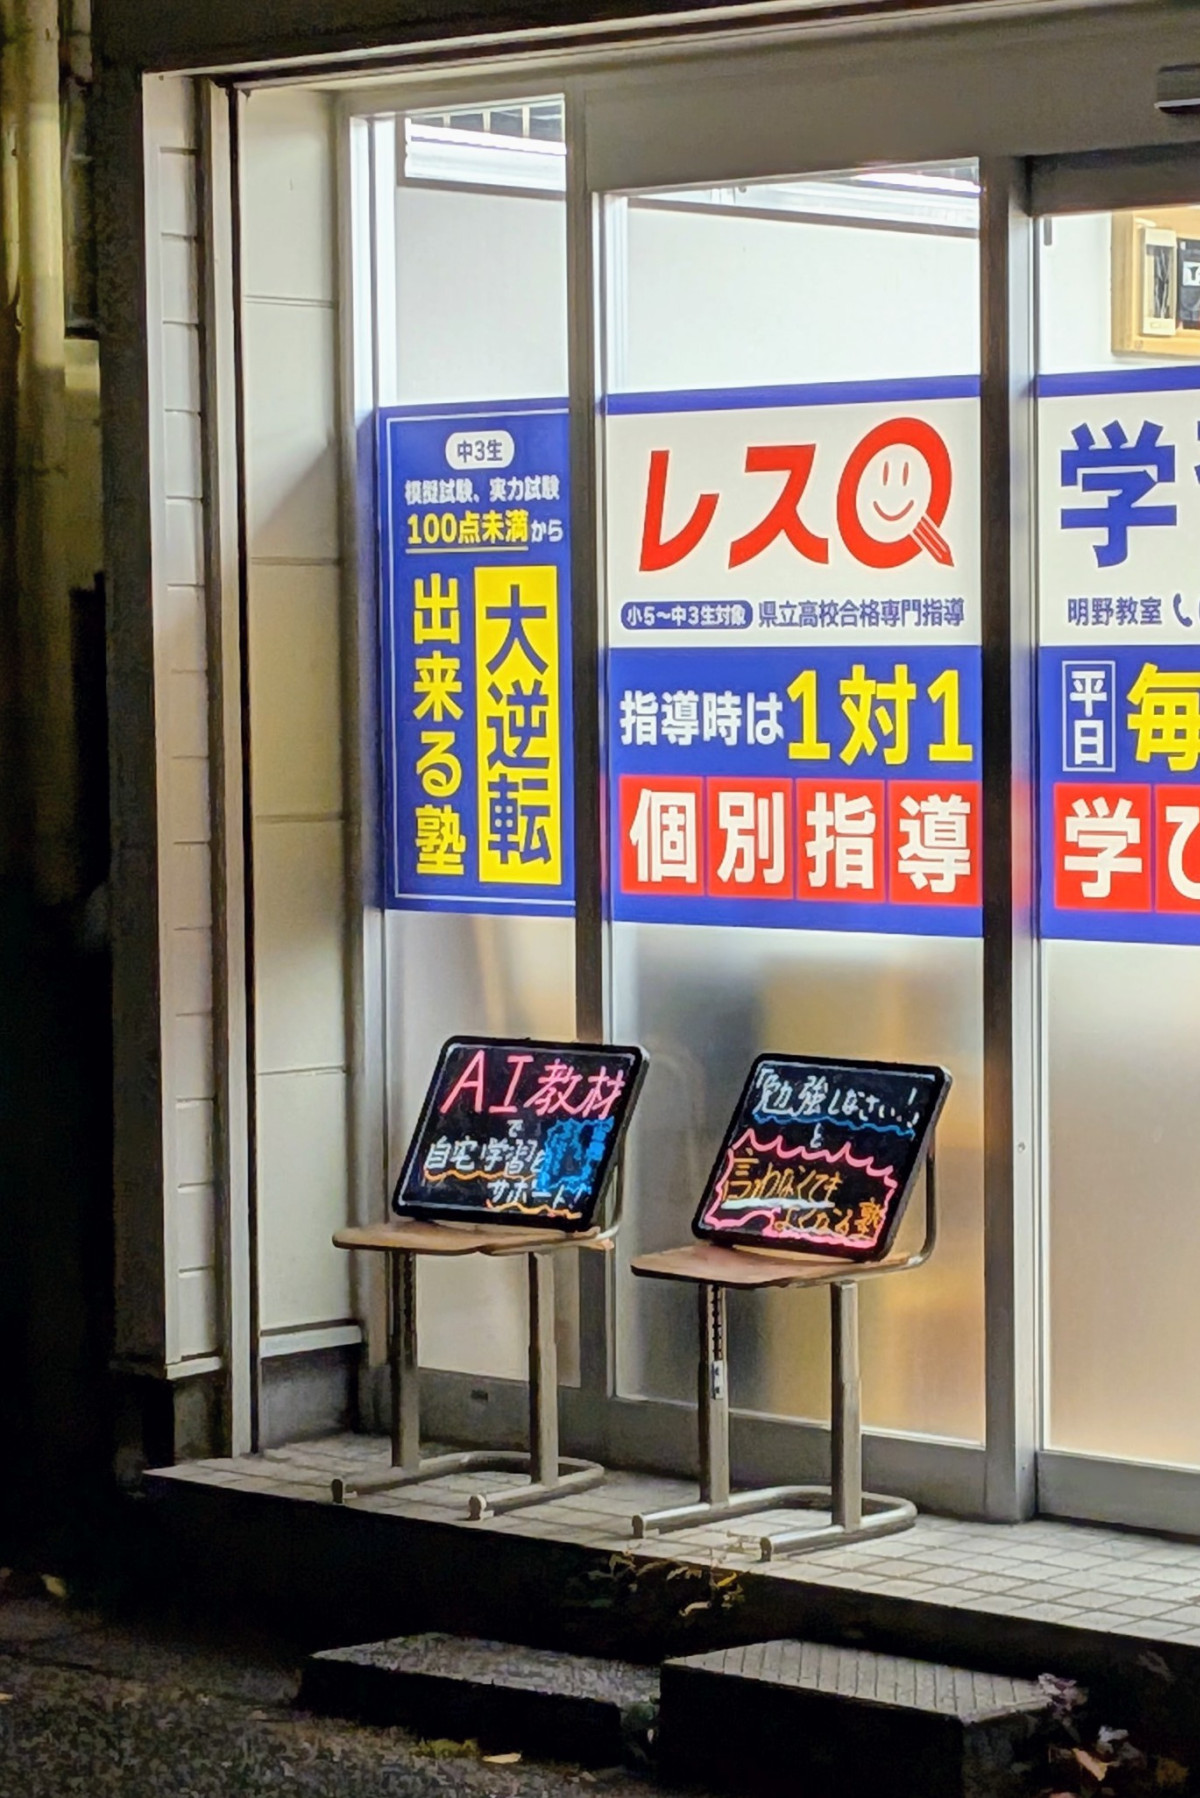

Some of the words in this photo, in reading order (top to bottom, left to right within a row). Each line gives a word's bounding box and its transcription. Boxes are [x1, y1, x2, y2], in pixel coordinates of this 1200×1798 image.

[457, 439, 503, 463] 中3生
[407, 509, 564, 544] 100点未満から
[758, 598, 965, 628] 県立高校合格専門指導
[1067, 597, 1163, 627] 明野教室
[411, 572, 467, 876] 出来る塾
[485, 583, 553, 866] 大逆転
[1069, 670, 1108, 766] 平日
[629, 788, 972, 894] 個別指導
